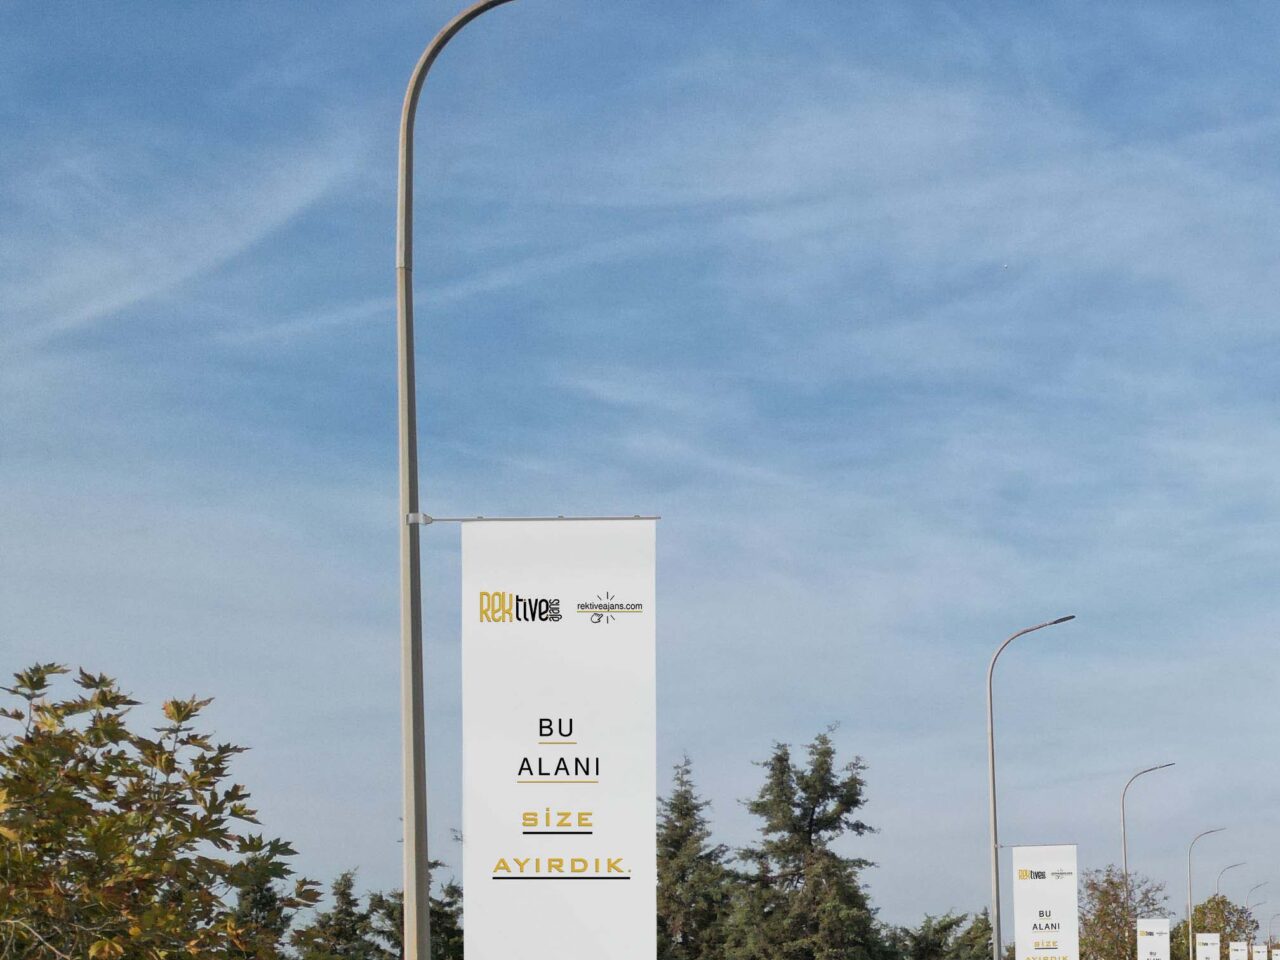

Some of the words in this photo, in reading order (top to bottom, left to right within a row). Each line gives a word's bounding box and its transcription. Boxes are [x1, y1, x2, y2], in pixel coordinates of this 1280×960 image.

[577, 601, 643, 612] rektiveajans.com
[538, 718, 574, 737] BU
[517, 756, 600, 777] ALANI
[521, 807, 594, 828] SİZE
[492, 857, 632, 874] AYIRDIK.
[1038, 910, 1051, 918] BU
[1032, 922, 1060, 931] ALANI
